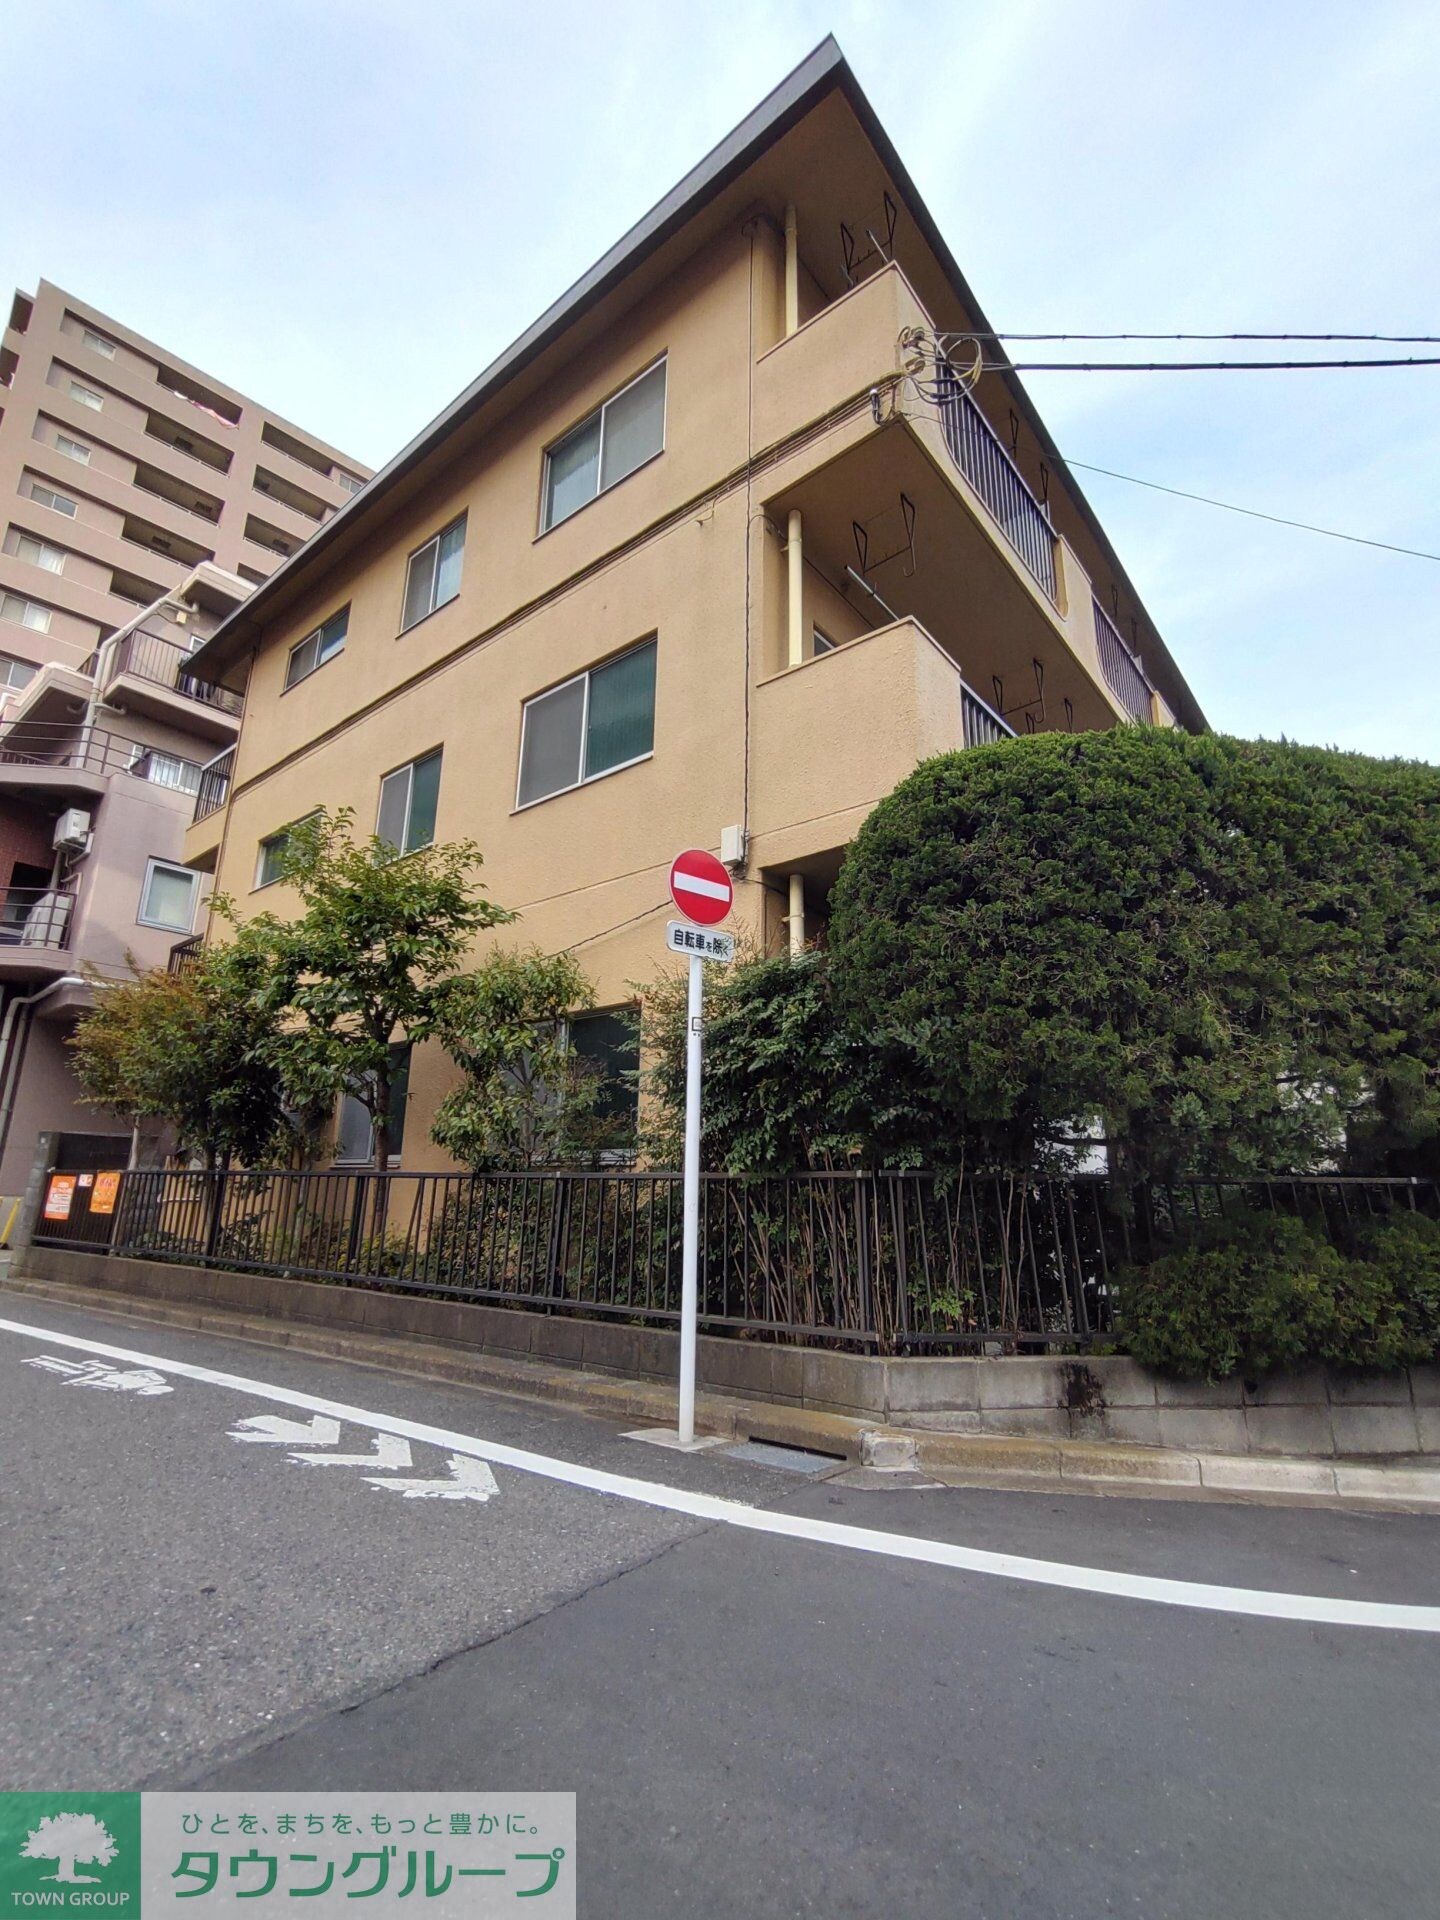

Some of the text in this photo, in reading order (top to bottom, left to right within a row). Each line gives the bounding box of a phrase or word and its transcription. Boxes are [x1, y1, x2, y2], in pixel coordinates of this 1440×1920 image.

[674, 929, 729, 957] 自転車を除く
